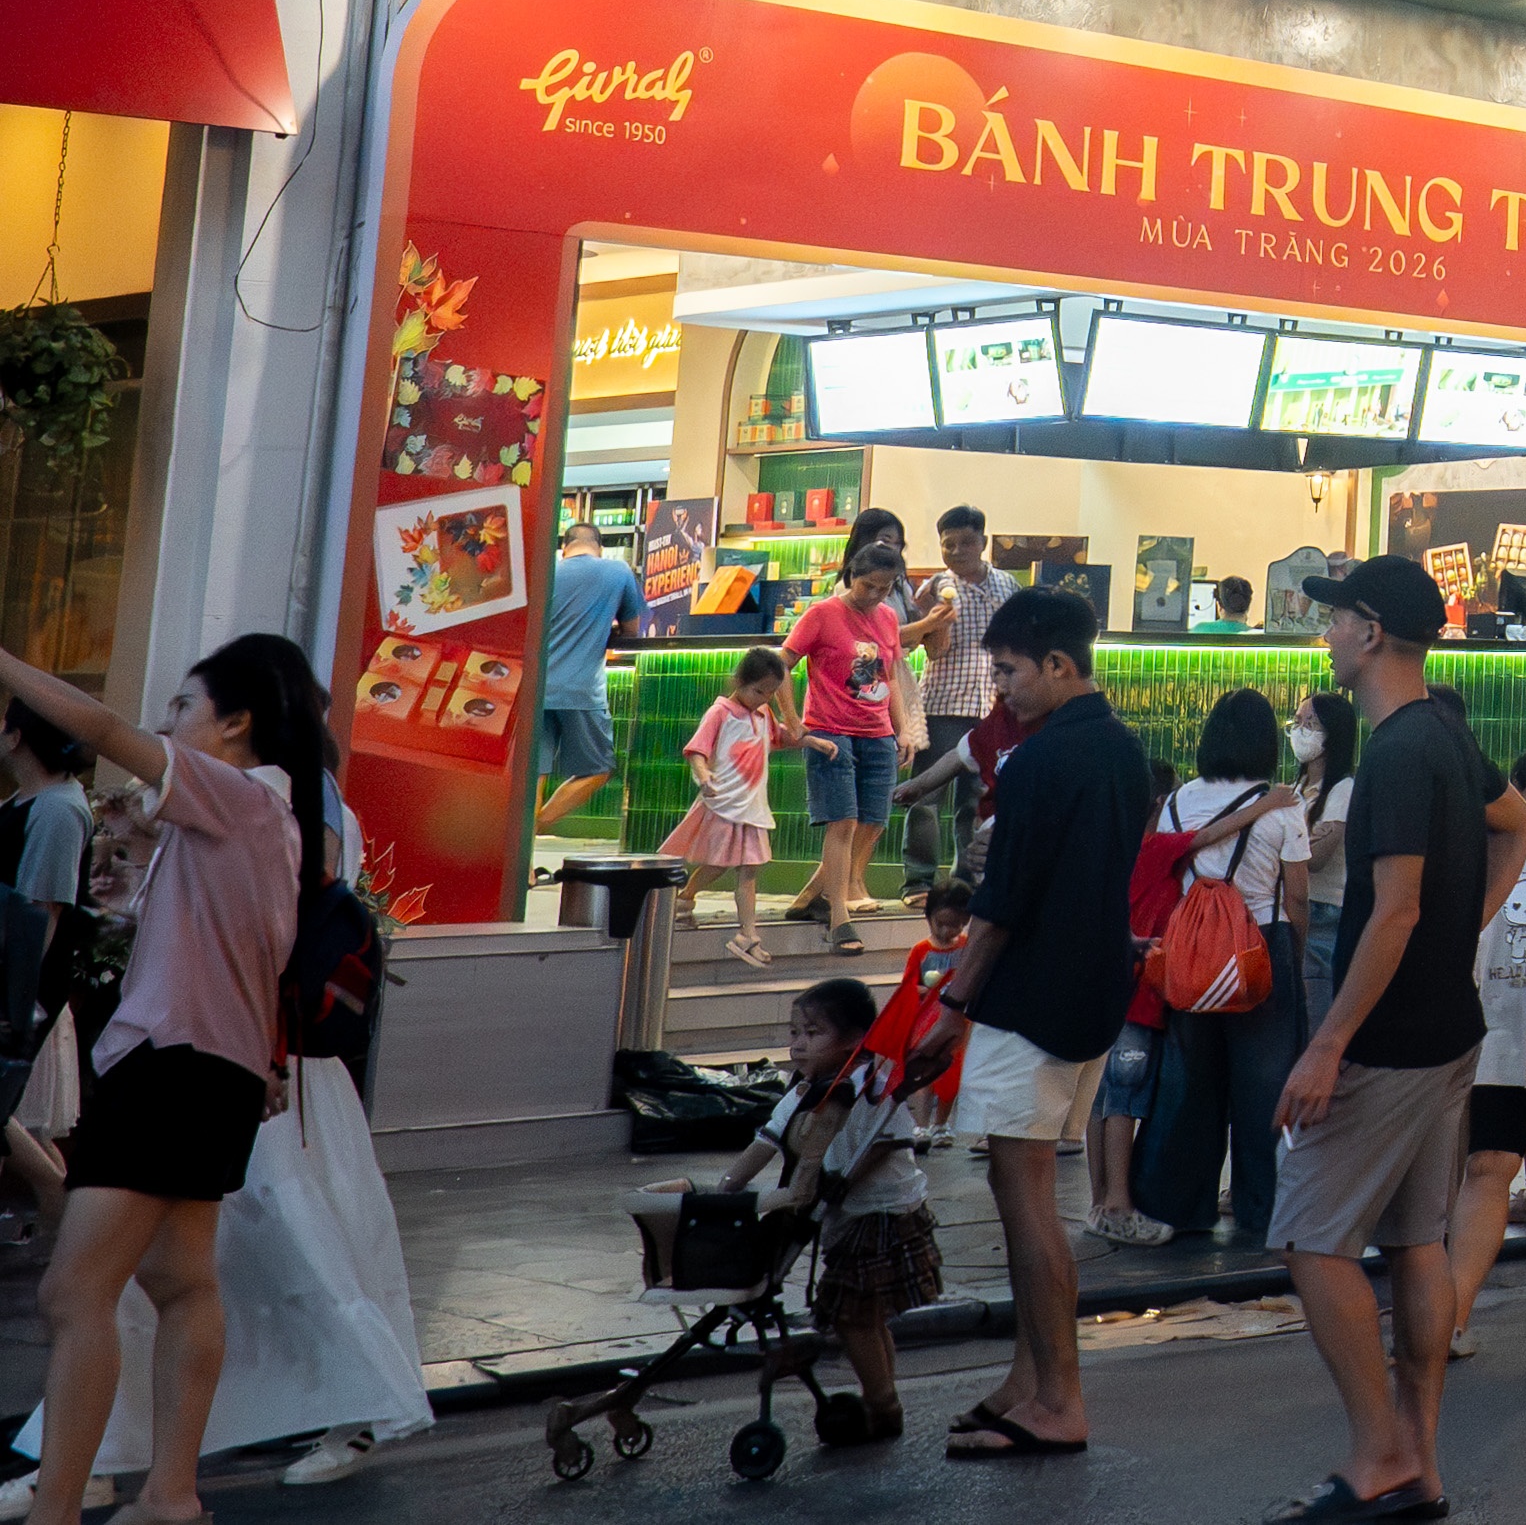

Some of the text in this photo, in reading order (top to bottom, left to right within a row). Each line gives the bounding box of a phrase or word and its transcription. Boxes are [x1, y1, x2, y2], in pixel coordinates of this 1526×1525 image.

[565, 118, 666, 145] since 1950
[900, 86, 1159, 201] BÁNH
[1191, 143, 1463, 243] TRUNG
[1140, 214, 1447, 281] MÙA TRĂNG 2026
[644, 560, 701, 602] EXPERIENC
[646, 544, 679, 577] HANOI
